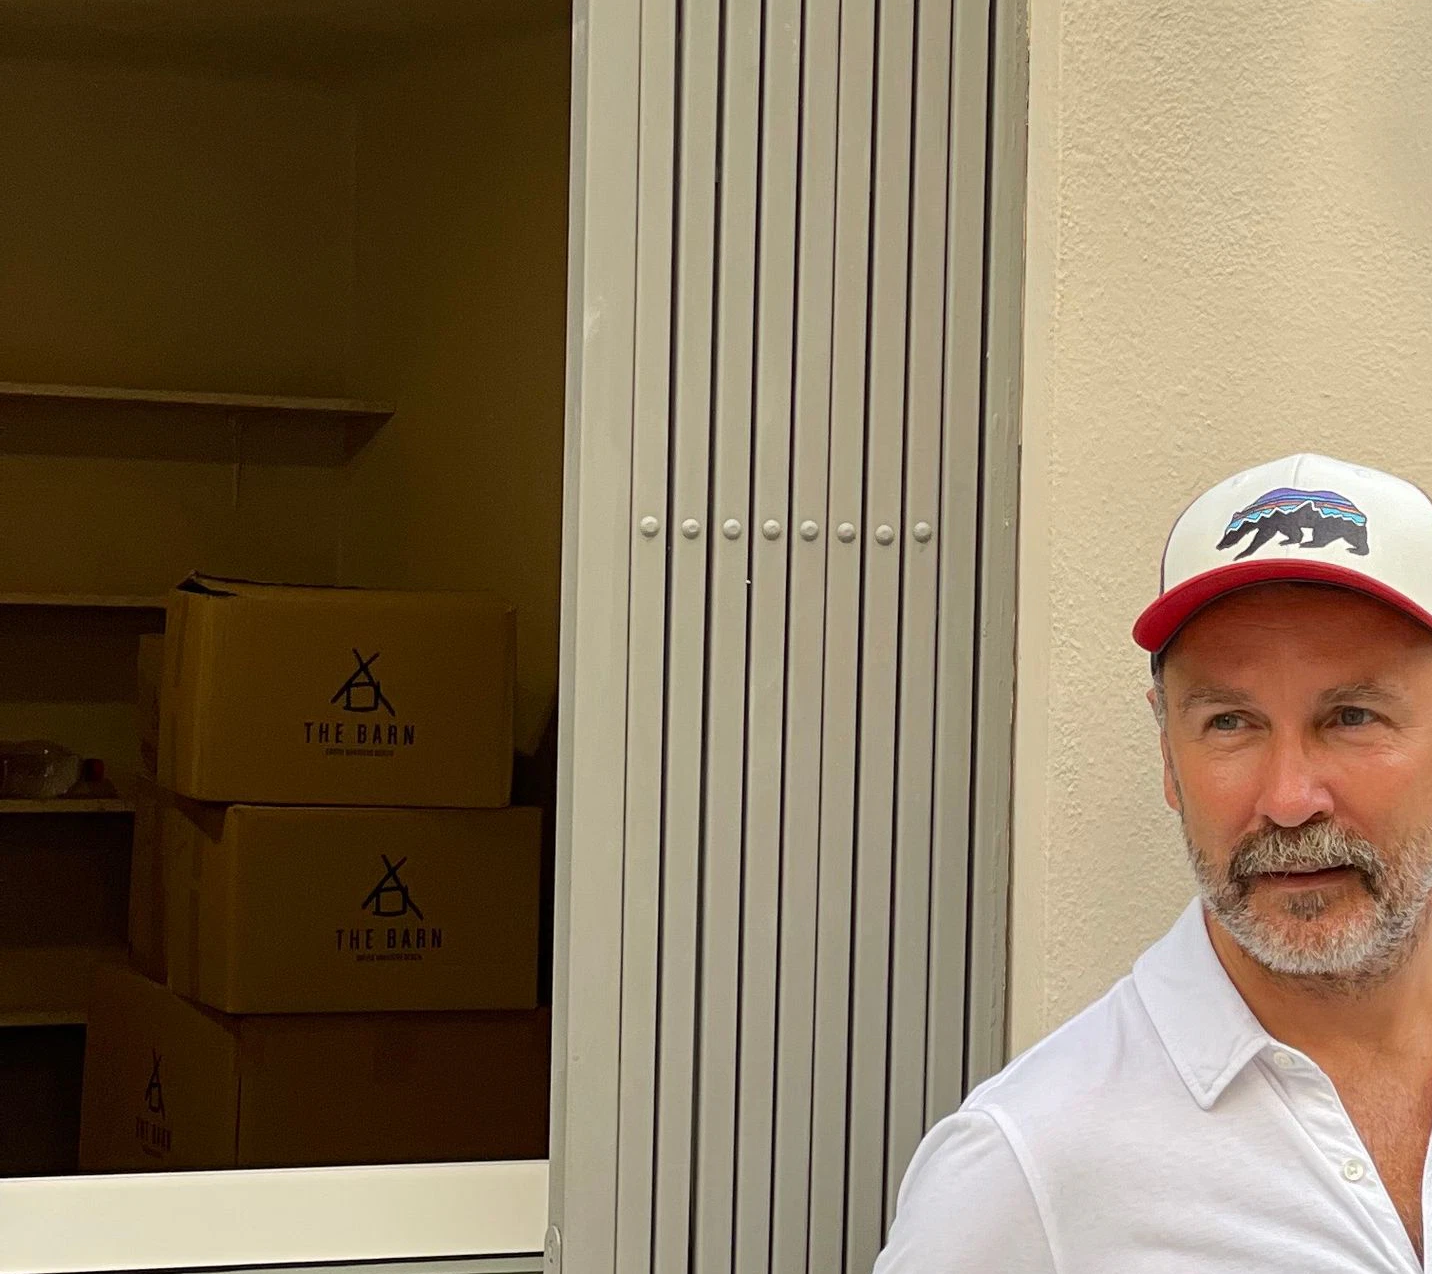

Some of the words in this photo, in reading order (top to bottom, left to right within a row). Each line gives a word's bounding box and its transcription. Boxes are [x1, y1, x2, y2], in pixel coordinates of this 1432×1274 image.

[304, 722, 344, 744] THE
[357, 722, 415, 745] BARN
[336, 928, 374, 951] THE
[386, 927, 442, 949] BARN
